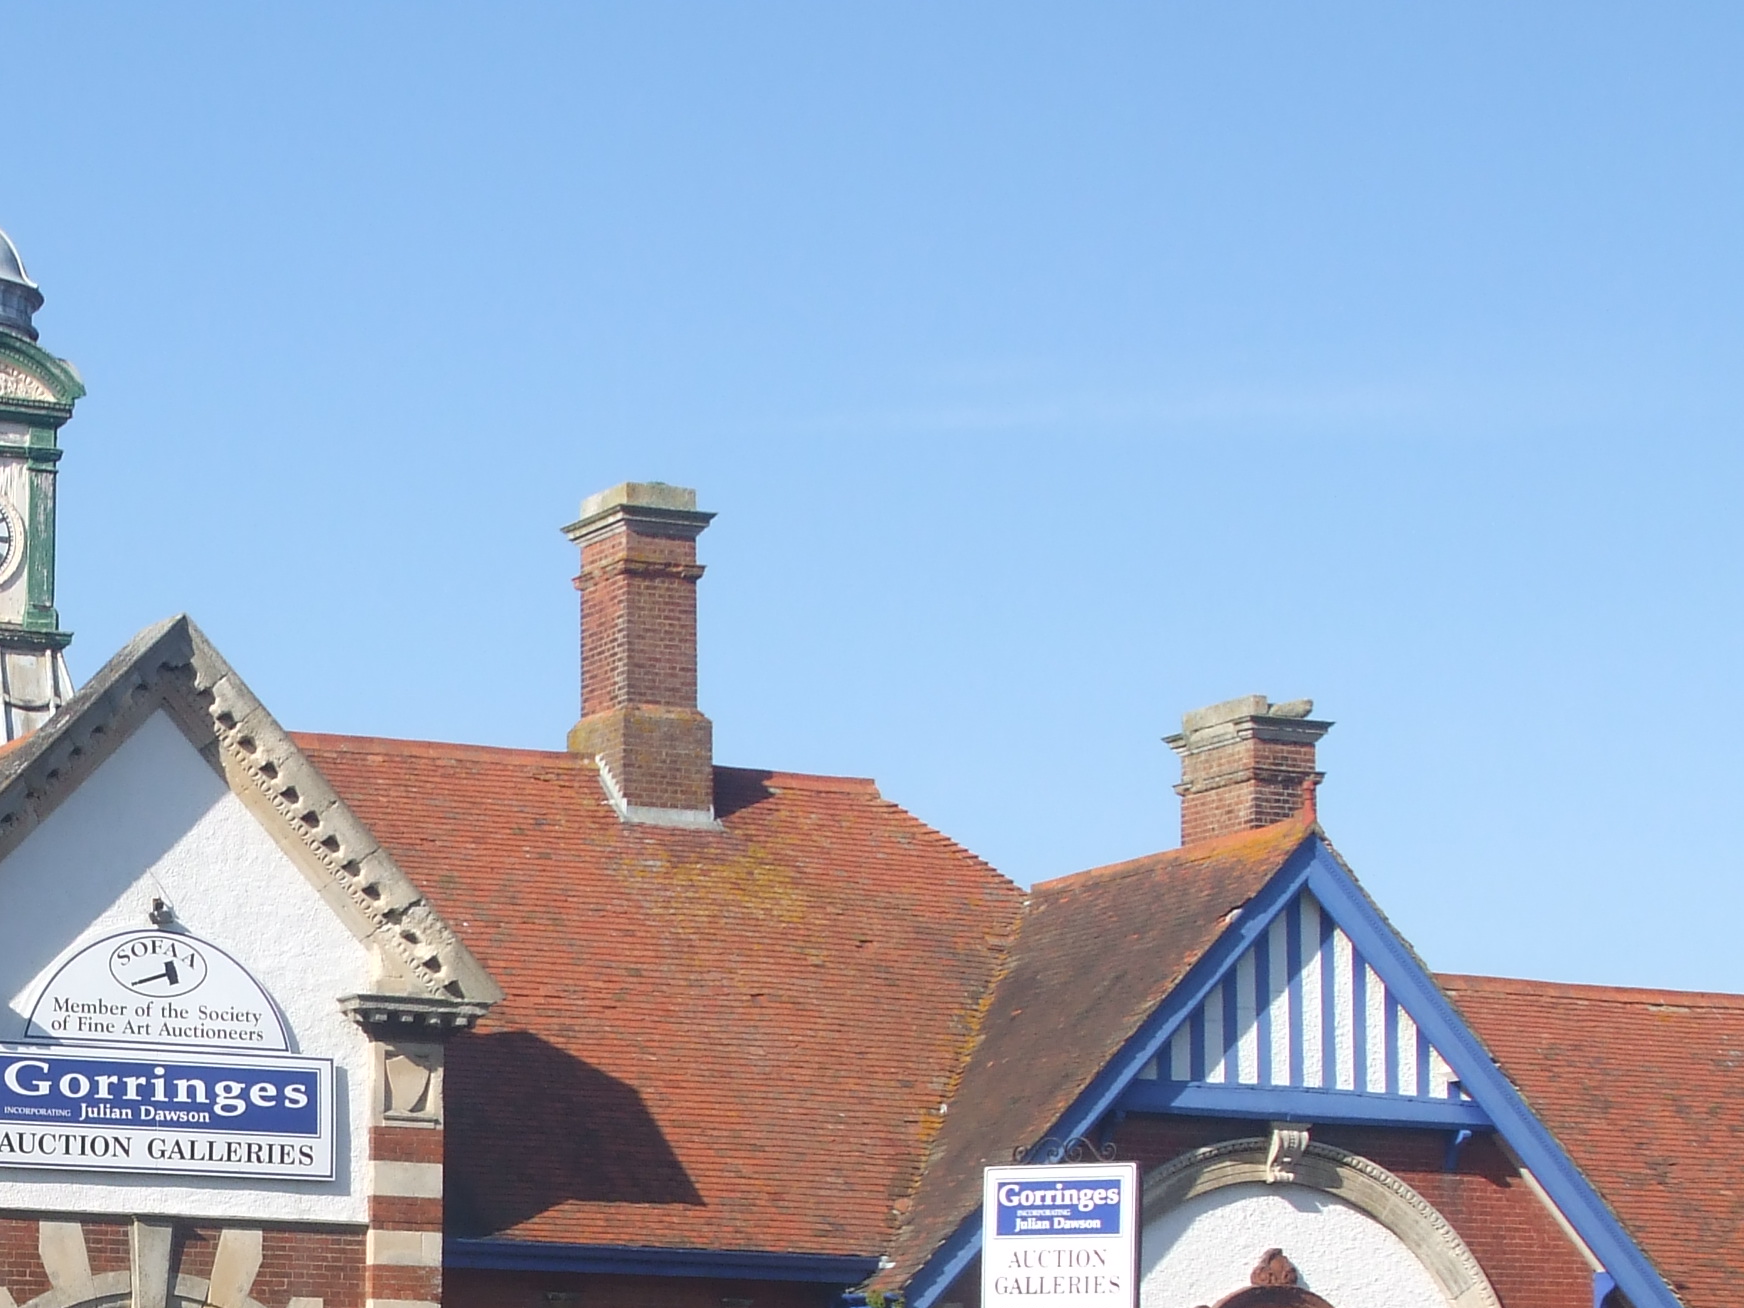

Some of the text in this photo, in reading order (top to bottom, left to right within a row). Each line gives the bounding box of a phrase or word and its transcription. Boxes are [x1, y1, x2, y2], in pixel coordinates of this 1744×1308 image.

[116, 938, 196, 970] SOFAA
[54, 997, 262, 1026] Member of the Society
[51, 1015, 263, 1041] of Fine Art Auctioneers
[4, 1060, 309, 1116] Gorringes
[4, 1103, 210, 1123] INCORPORATING Julian Dawson
[147, 1139, 314, 1166] GALLERIES
[999, 1184, 1119, 1212] Gorringes
[1014, 1217, 1101, 1232] Julian Dawson
[1008, 1249, 1106, 1269] AUCTION
[995, 1276, 1121, 1295] GALLERIES
